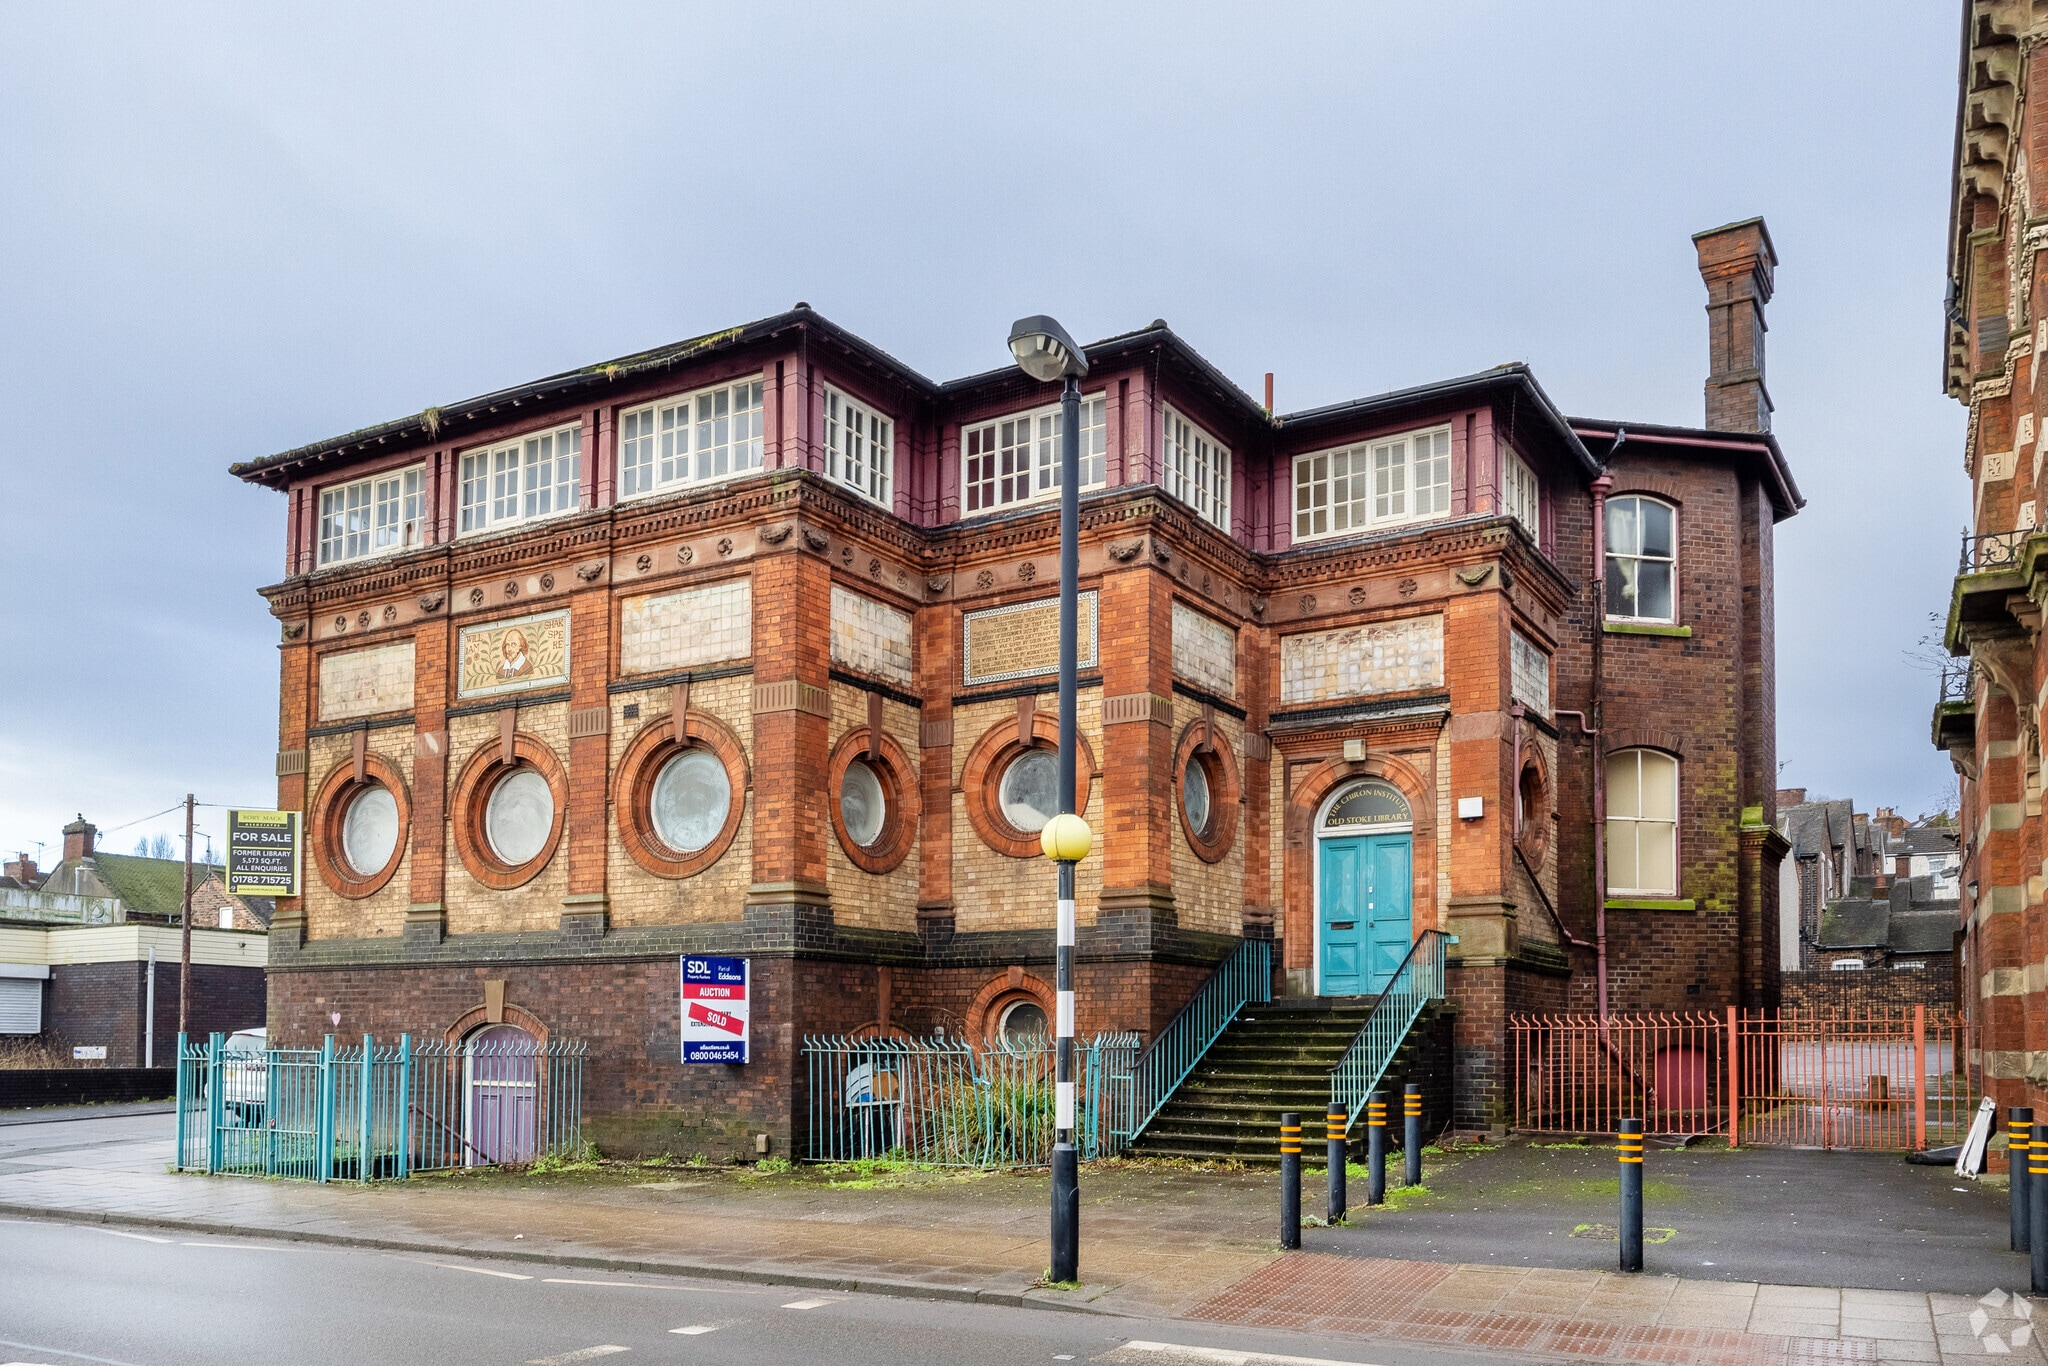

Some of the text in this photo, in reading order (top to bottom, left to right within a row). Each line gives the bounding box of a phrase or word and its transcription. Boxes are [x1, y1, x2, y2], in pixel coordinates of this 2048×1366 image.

[544, 619, 564, 629] SHAK
[548, 631, 564, 639] SPE
[553, 641, 563, 649] RE
[1329, 789, 1408, 817] THE CHIRON INSTITUTE
[1347, 816, 1371, 824] STOKE
[1374, 813, 1408, 822] LIBRARY
[233, 832, 292, 842] FOR SALE
[688, 960, 711, 974] SDL
[718, 972, 741, 980] Eddisons
[700, 988, 730, 997] AUCTION
[707, 1011, 726, 1026] SOLD
[691, 1052, 708, 1060] 0800
[723, 1051, 739, 1059] 5454
